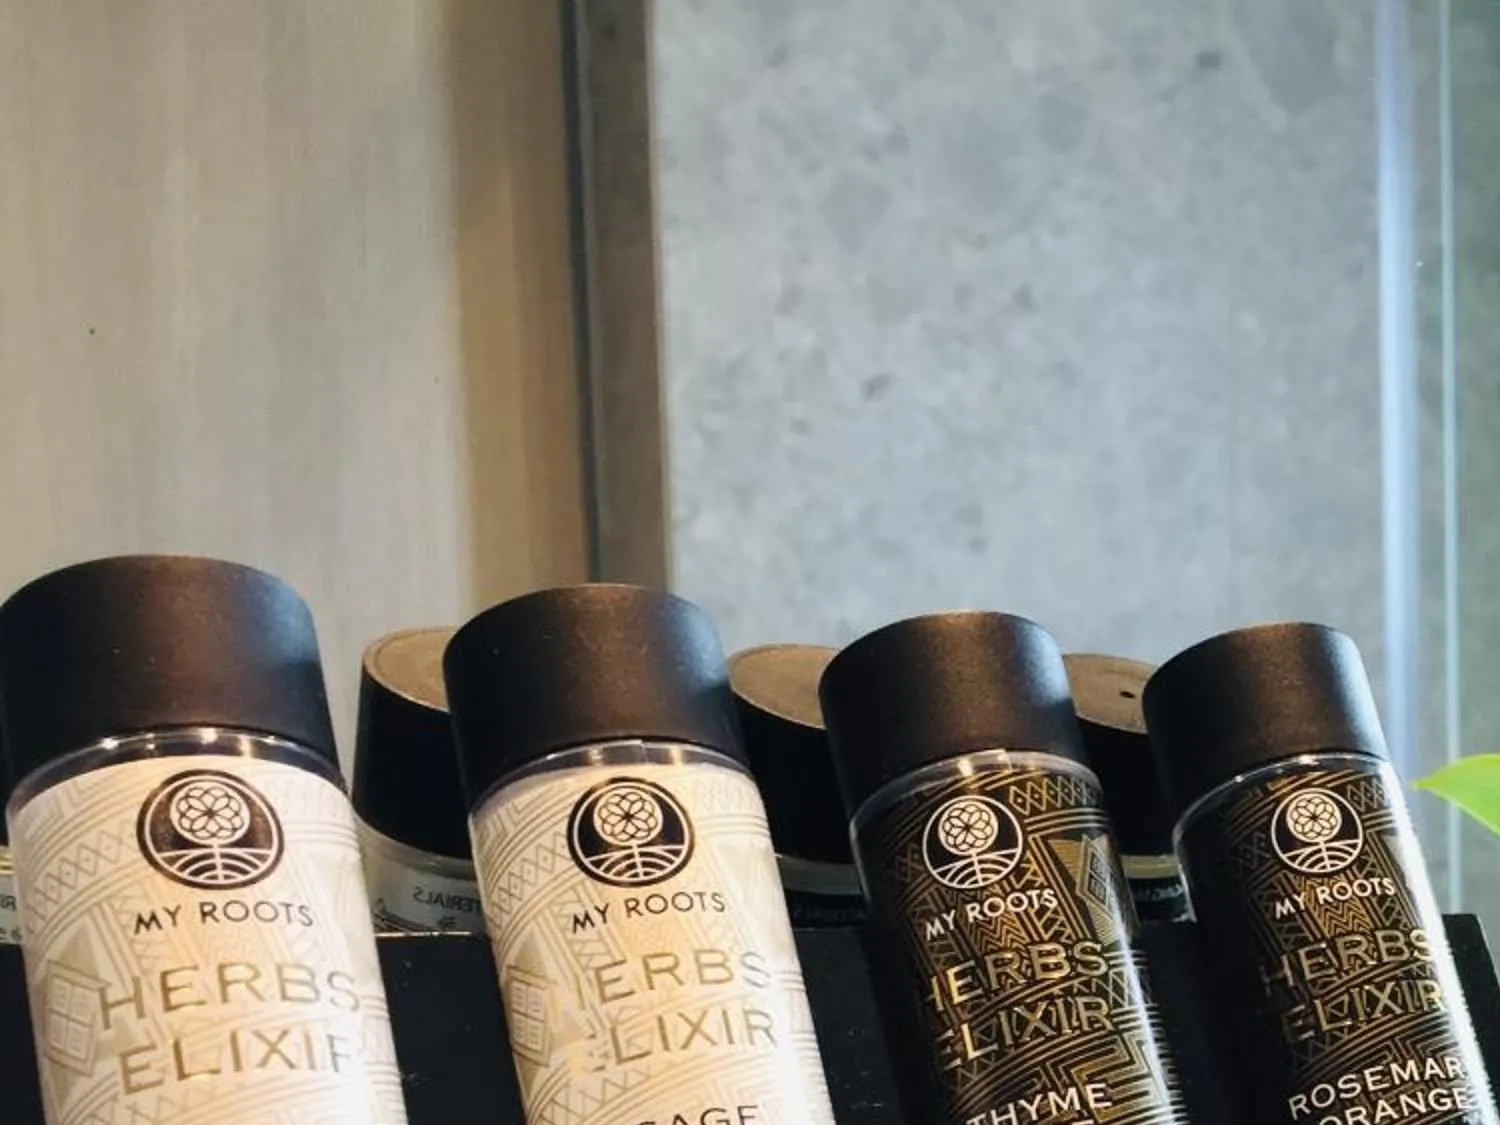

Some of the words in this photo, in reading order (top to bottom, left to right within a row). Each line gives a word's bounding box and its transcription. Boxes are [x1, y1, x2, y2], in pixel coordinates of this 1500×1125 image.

[134, 904, 182, 935] MY
[200, 900, 313, 927] ROOTS
[572, 903, 610, 934] MY
[624, 891, 726, 918] ROOTS
[925, 909, 956, 941] MY
[966, 889, 1058, 923] ROOTS
[1275, 893, 1307, 919] MY
[1316, 877, 1395, 905] ROOTS
[99, 962, 360, 1031] HERBS
[1288, 1056, 1467, 1120] ROSEMAR
